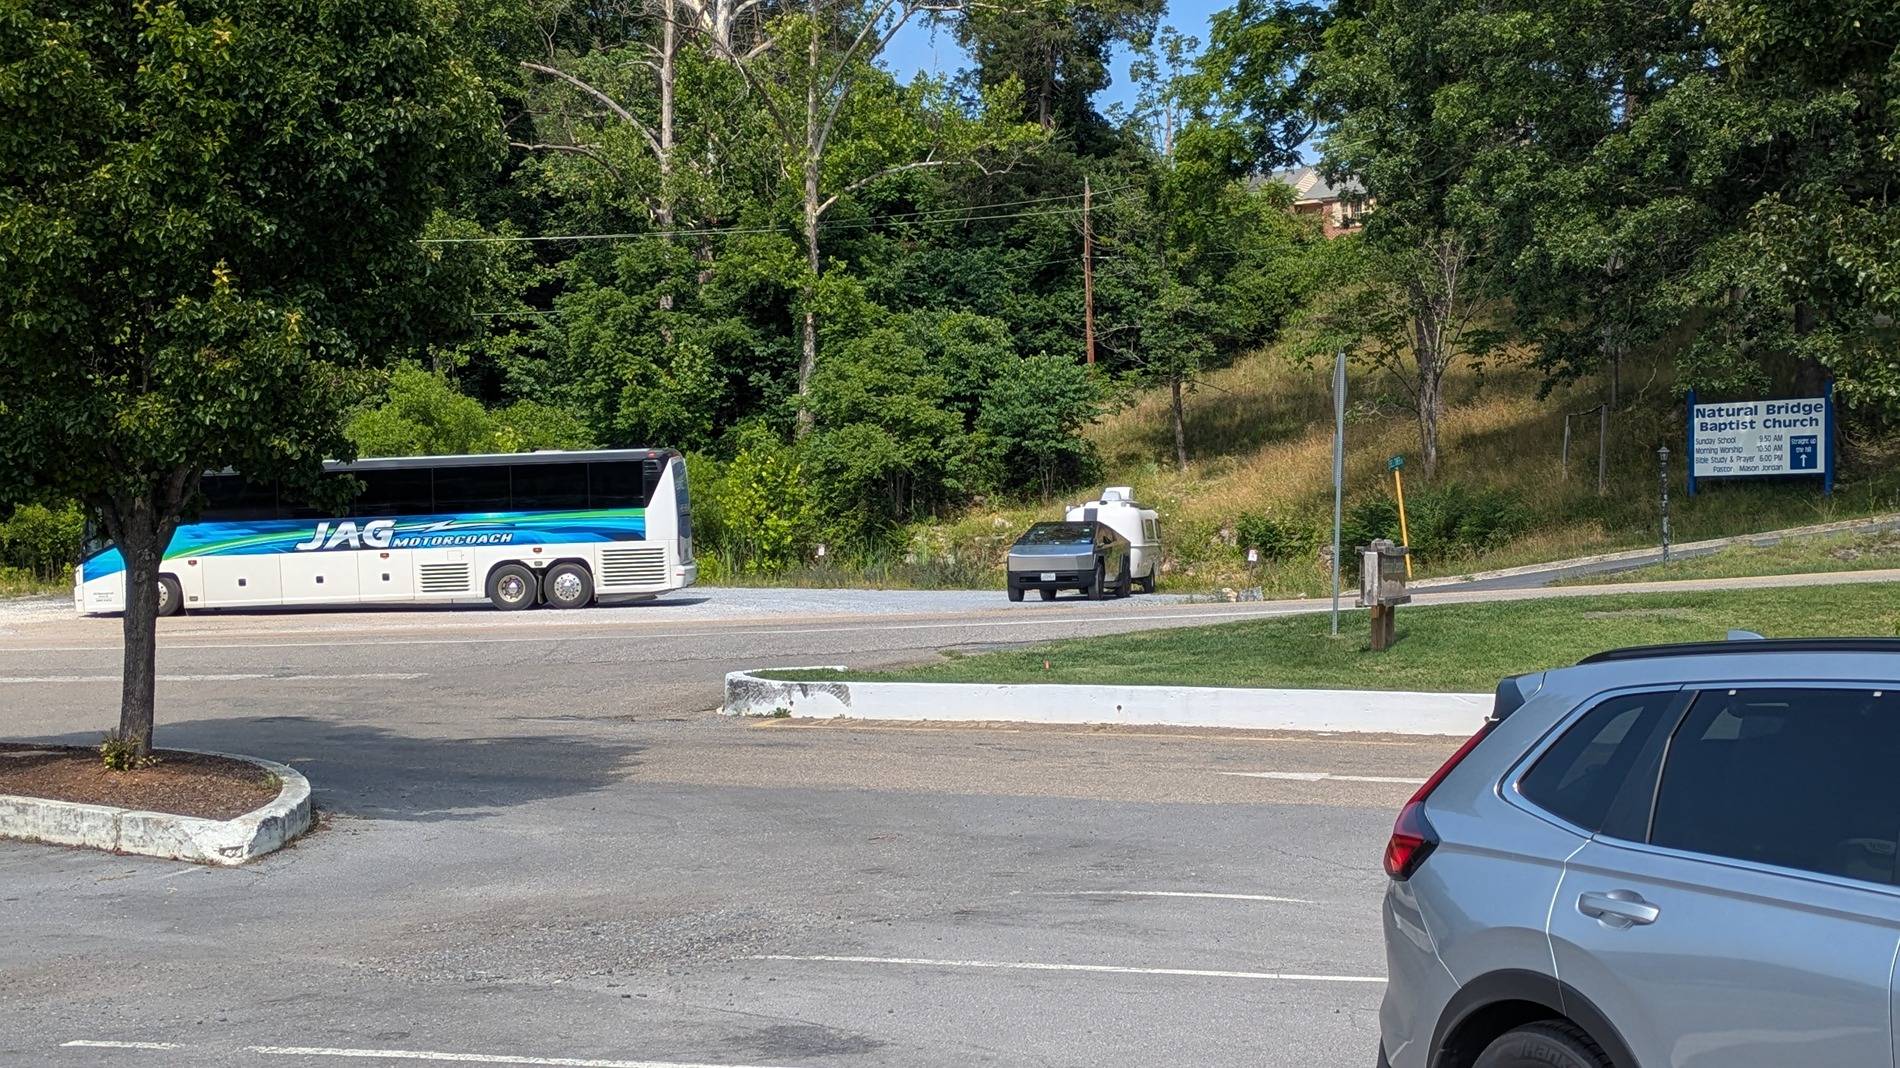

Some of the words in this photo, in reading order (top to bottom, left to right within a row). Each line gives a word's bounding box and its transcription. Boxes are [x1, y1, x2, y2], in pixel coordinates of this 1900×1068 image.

[1695, 405, 1758, 419] Natural
[1766, 402, 1824, 416] Bridge
[1700, 419, 1756, 433] Baptist
[1763, 416, 1819, 429] Church
[1695, 438, 1716, 446] Sunday
[1717, 436, 1737, 445] School
[1773, 433, 1784, 442] AM
[1695, 447, 1719, 455] Morning
[1719, 446, 1744, 454] Worship
[1773, 443, 1784, 452] AM
[1710, 456, 1728, 464] Study
[1736, 455, 1756, 463] Prayer
[1773, 453, 1784, 462] PM
[1761, 464, 1784, 472] Jordan
[295, 518, 398, 551] JAG
[393, 533, 514, 548] MOTORCOACH
